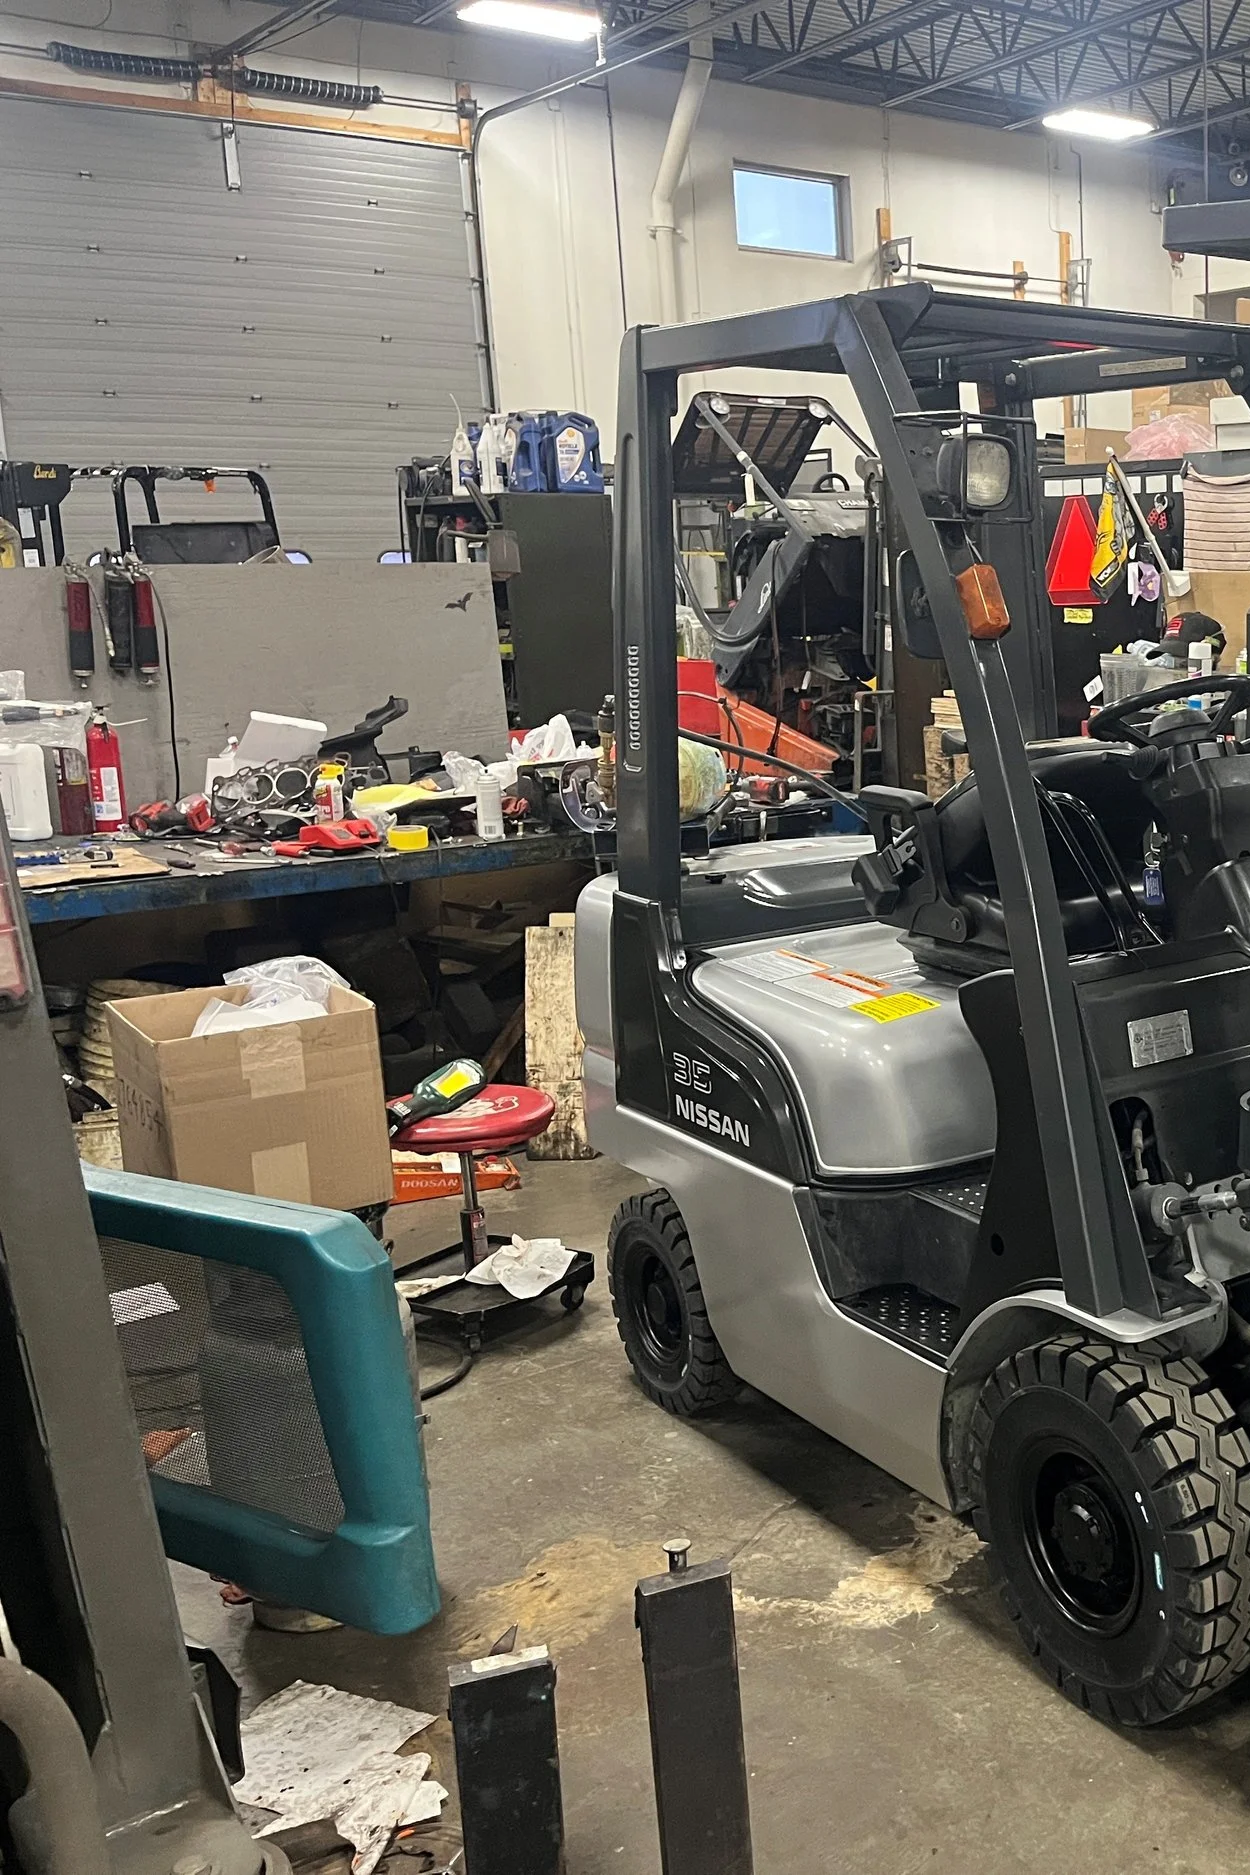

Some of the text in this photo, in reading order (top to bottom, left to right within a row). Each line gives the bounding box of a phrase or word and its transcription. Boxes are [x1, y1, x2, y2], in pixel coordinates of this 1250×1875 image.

[672, 1052, 712, 1094] 35
[675, 1093, 750, 1147] NISSAN
[401, 1178, 458, 1188] DOOSAN
